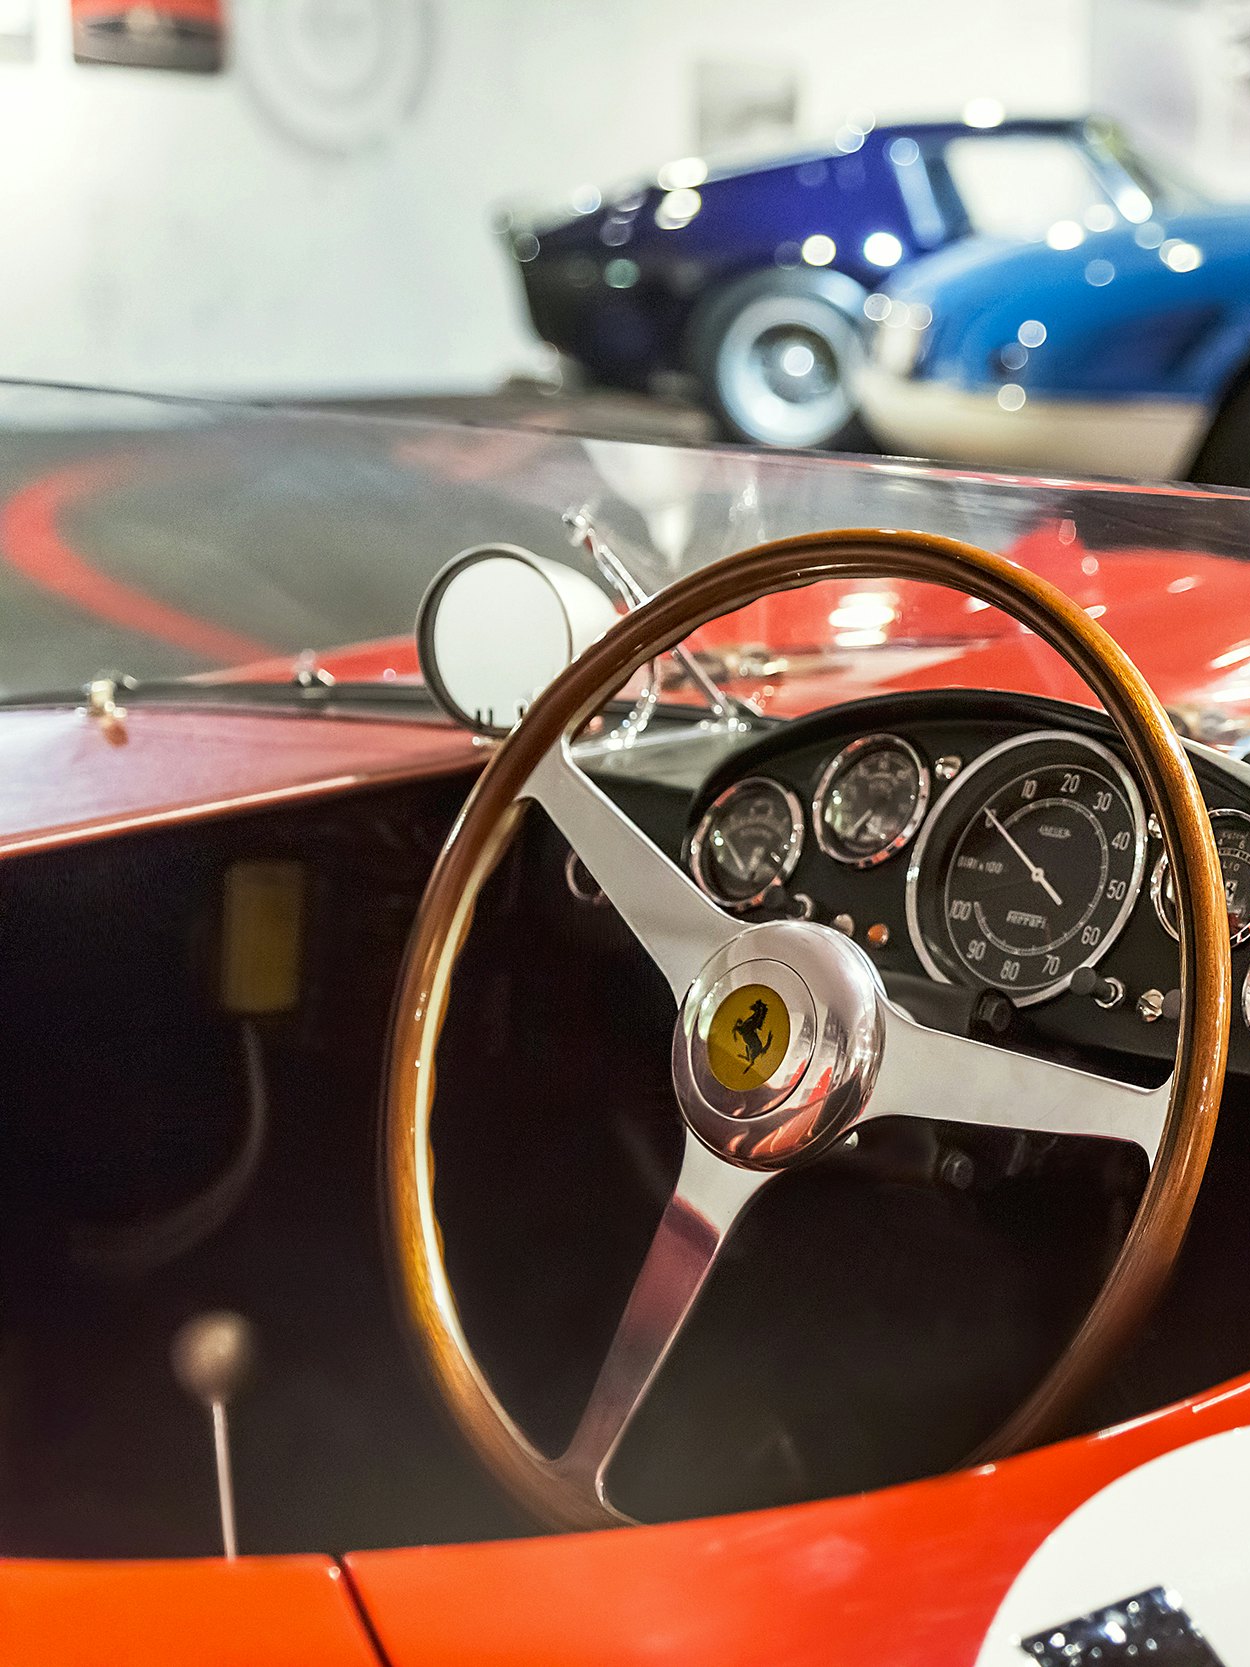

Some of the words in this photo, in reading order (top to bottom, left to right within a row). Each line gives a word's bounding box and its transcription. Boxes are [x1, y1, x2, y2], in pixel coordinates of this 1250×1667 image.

[1021, 779, 1037, 799] 10
[1061, 773, 1080, 793] 20
[1093, 791, 1112, 812] 30
[1112, 831, 1130, 850] 40
[1239, 840, 1245, 850] 6
[1107, 880, 1126, 900] 50
[949, 900, 972, 920] 100
[1081, 926, 1100, 946] 60
[967, 940, 986, 961] 90
[1000, 961, 1019, 981] 80
[1041, 955, 1060, 976] 70
